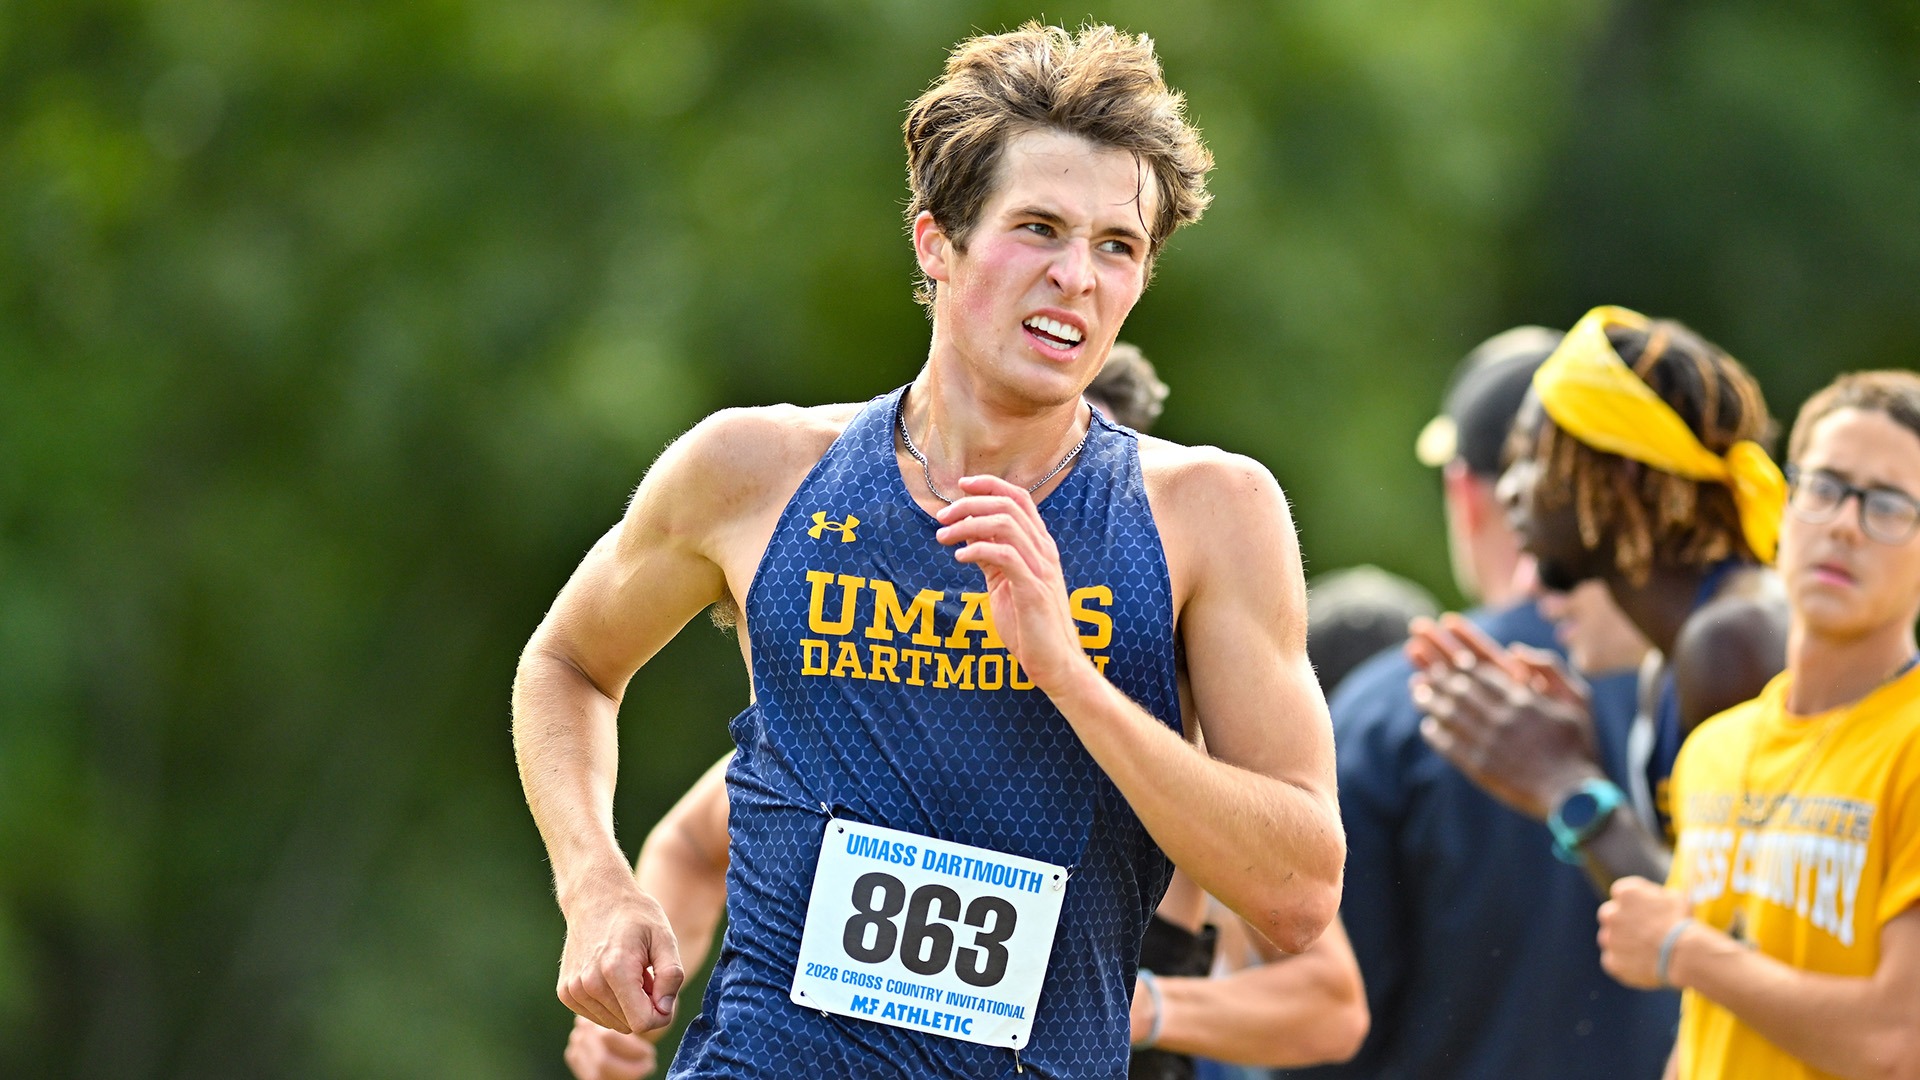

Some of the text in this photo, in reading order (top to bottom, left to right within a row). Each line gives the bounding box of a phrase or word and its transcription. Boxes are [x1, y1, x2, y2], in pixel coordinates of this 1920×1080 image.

[806, 570, 1114, 650] UMAS
[800, 638, 1110, 691] DARTMOU
[846, 833, 1044, 894] UMASS DARTMOUTH
[842, 872, 1018, 988] 863
[805, 962, 1026, 1020] 2026 CROSS COUNTRY INVITATIONAL
[881, 1002, 973, 1036] ATHLETIC
